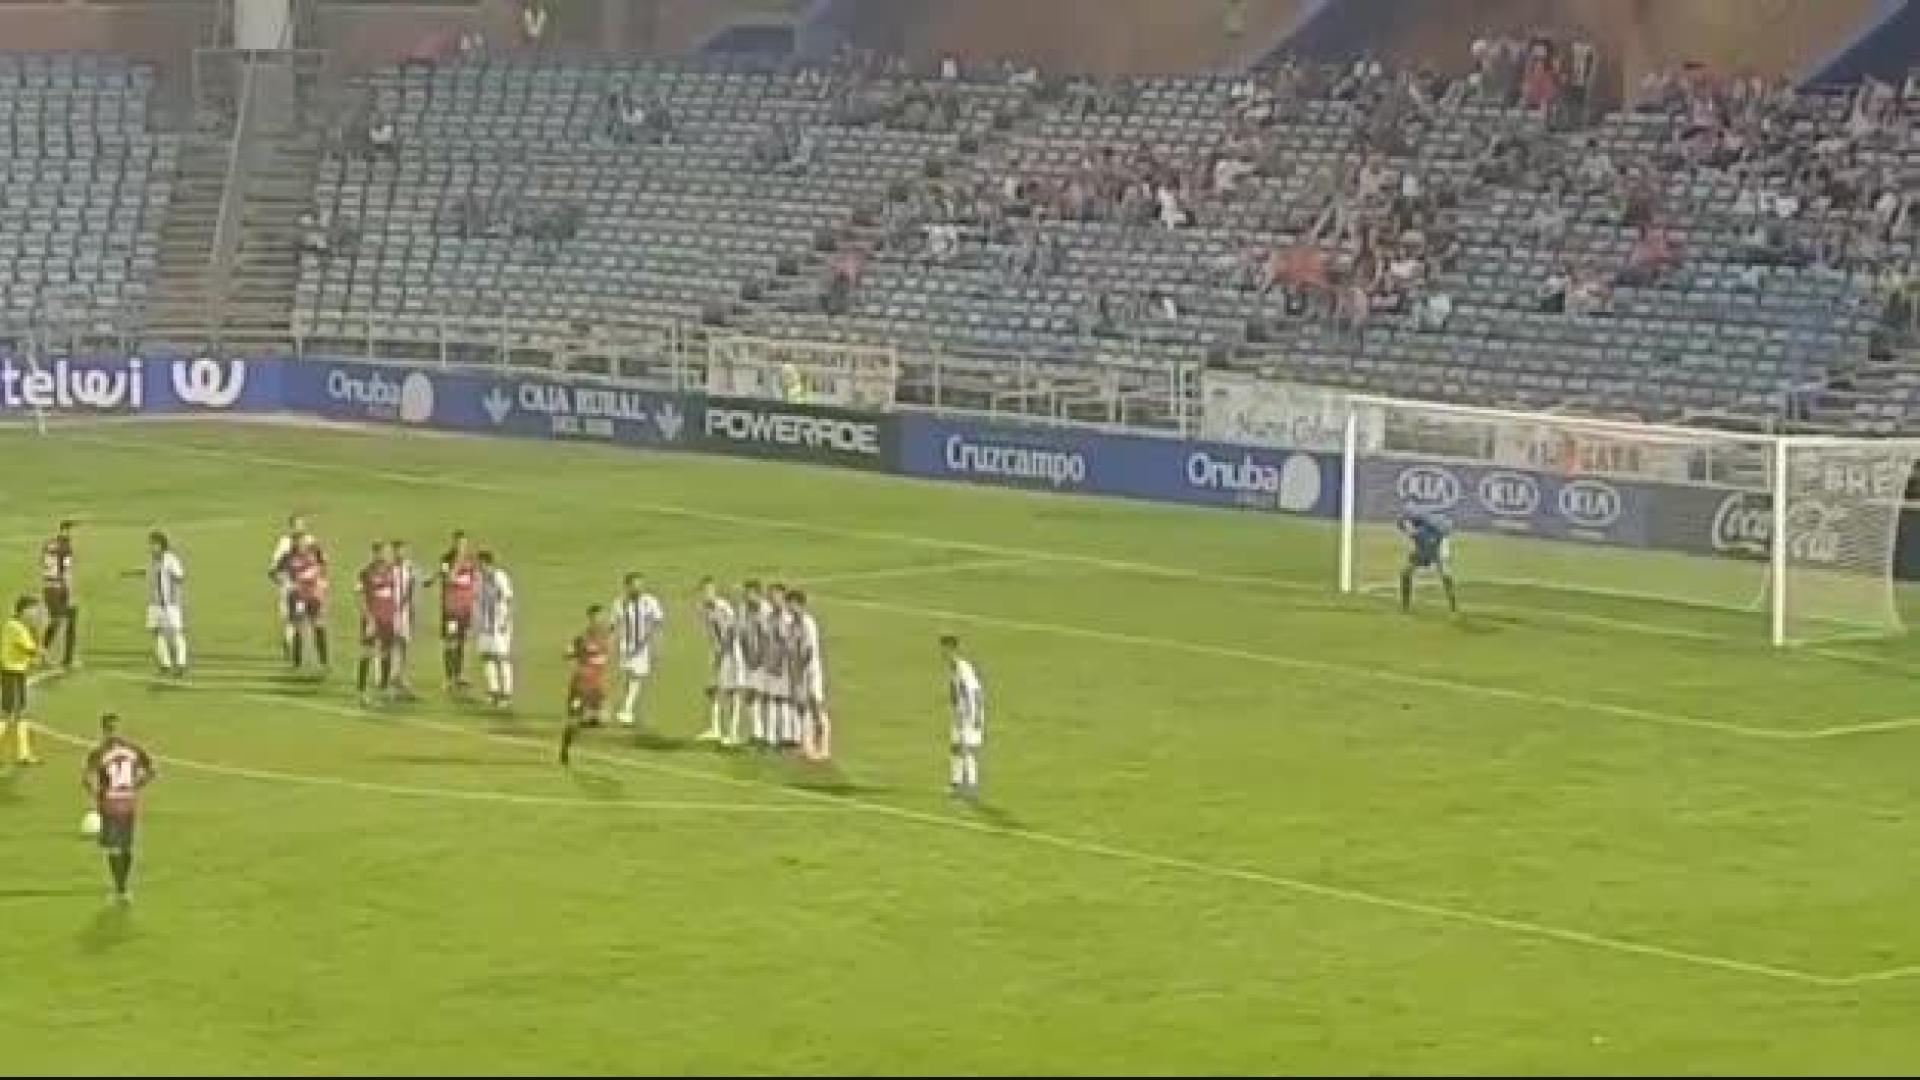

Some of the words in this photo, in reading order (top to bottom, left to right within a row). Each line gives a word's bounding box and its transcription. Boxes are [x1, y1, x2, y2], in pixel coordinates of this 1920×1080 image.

[327, 368, 400, 406] Onuba
[706, 407, 880, 453] POWERADE
[946, 433, 1086, 486] Cruzcampo
[1187, 452, 1279, 492] Onuba
